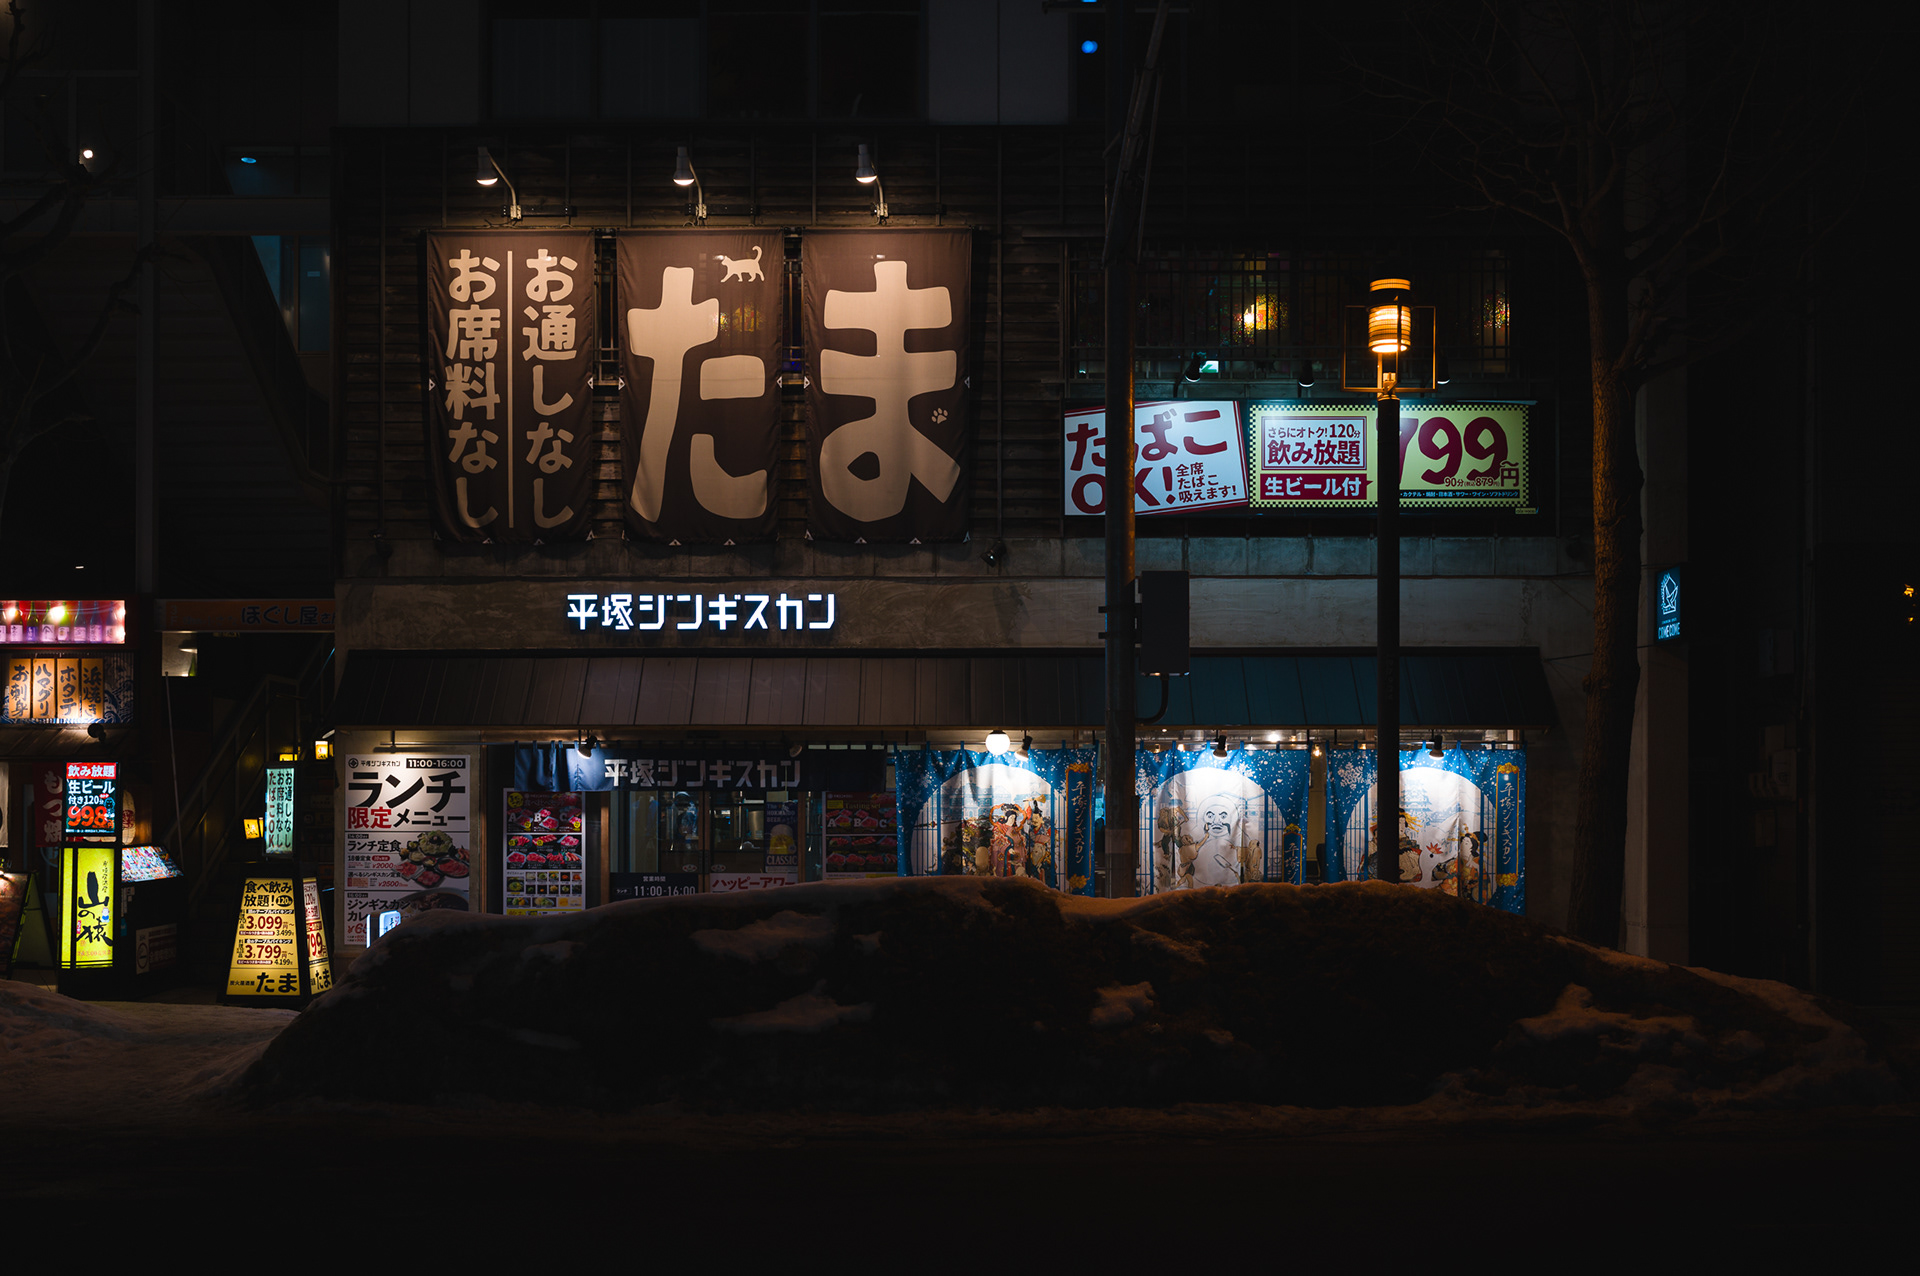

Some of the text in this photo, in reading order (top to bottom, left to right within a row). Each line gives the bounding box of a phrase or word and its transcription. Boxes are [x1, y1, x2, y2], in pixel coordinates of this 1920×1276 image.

[445, 249, 500, 528] お席料なし
[522, 249, 577, 528] お通しなし
[1067, 408, 1228, 471] たばこ
[1268, 440, 1360, 465] 飲み放題
[1176, 462, 1204, 477] 全席
[1178, 474, 1219, 490] たばこ
[1265, 476, 1361, 496] 生ビール付
[1179, 485, 1237, 503] 吸えます!
[567, 593, 835, 630] 平塚ジンギスカン
[36, 664, 53, 716] ハマグリ
[60, 666, 76, 716] ホタテ
[68, 765, 115, 777] 飲み放題
[408, 759, 464, 767] 11:00-16:00
[604, 759, 800, 788] 平塚ジンギスカン
[68, 780, 115, 794] 生ビール
[349, 771, 465, 812] ランチ
[276, 771, 284, 848] お席料なし
[285, 771, 293, 848] お通しなし
[348, 807, 465, 829] 限定メニュー
[1071, 781, 1088, 864] 平塚ジンギスカン
[1500, 782, 1516, 865] 平塚ジンギスカン
[348, 840, 401, 852] ランチ定食
[767, 855, 797, 865] CLASSIC
[1285, 842, 1299, 885] 平塚ジ
[245, 881, 292, 894] 食べ飲み
[634, 886, 695, 897] 11:00-16:00
[348, 899, 410, 910] ジンギスカン
[256, 972, 297, 993] たま
